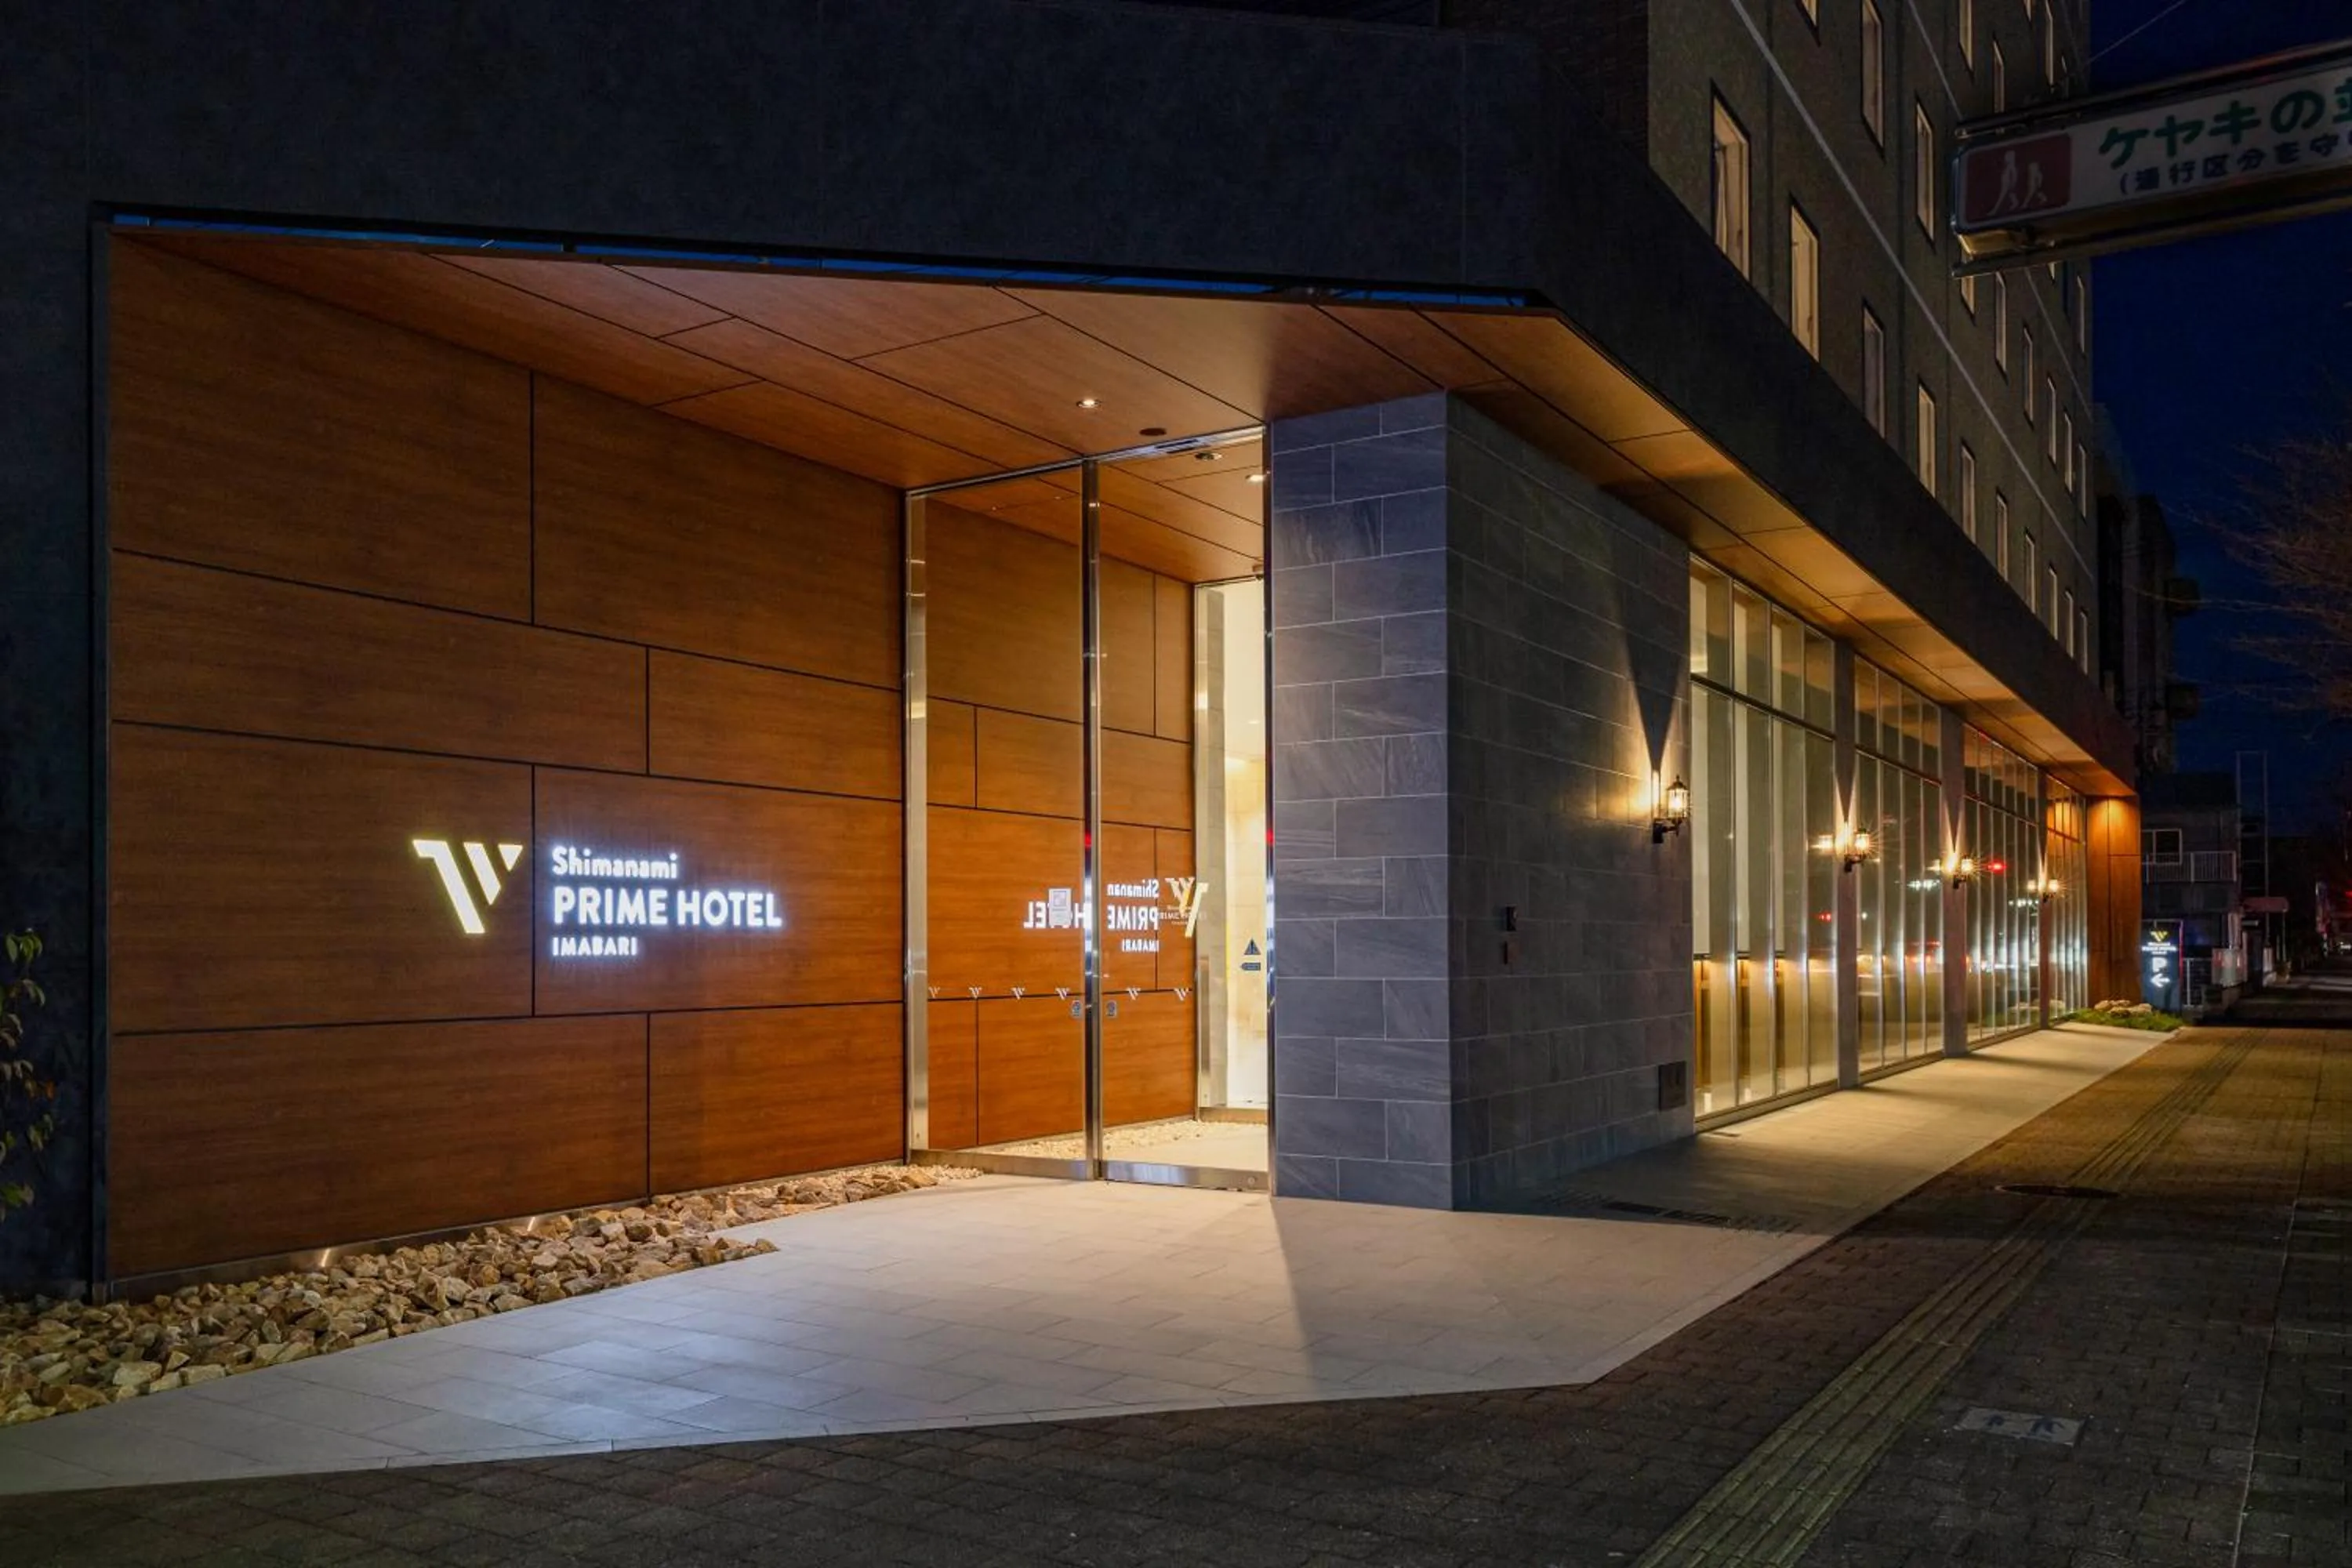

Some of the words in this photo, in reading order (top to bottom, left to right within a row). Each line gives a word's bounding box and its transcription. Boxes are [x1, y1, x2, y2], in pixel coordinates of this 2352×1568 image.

[2120, 129, 2352, 194] (通行区分を守
[553, 846, 677, 879] Shimanami
[554, 887, 668, 925] PRIME
[677, 889, 782, 927] HOTEL
[553, 937, 637, 956] IMABARI
[2152, 956, 2168, 973] P
